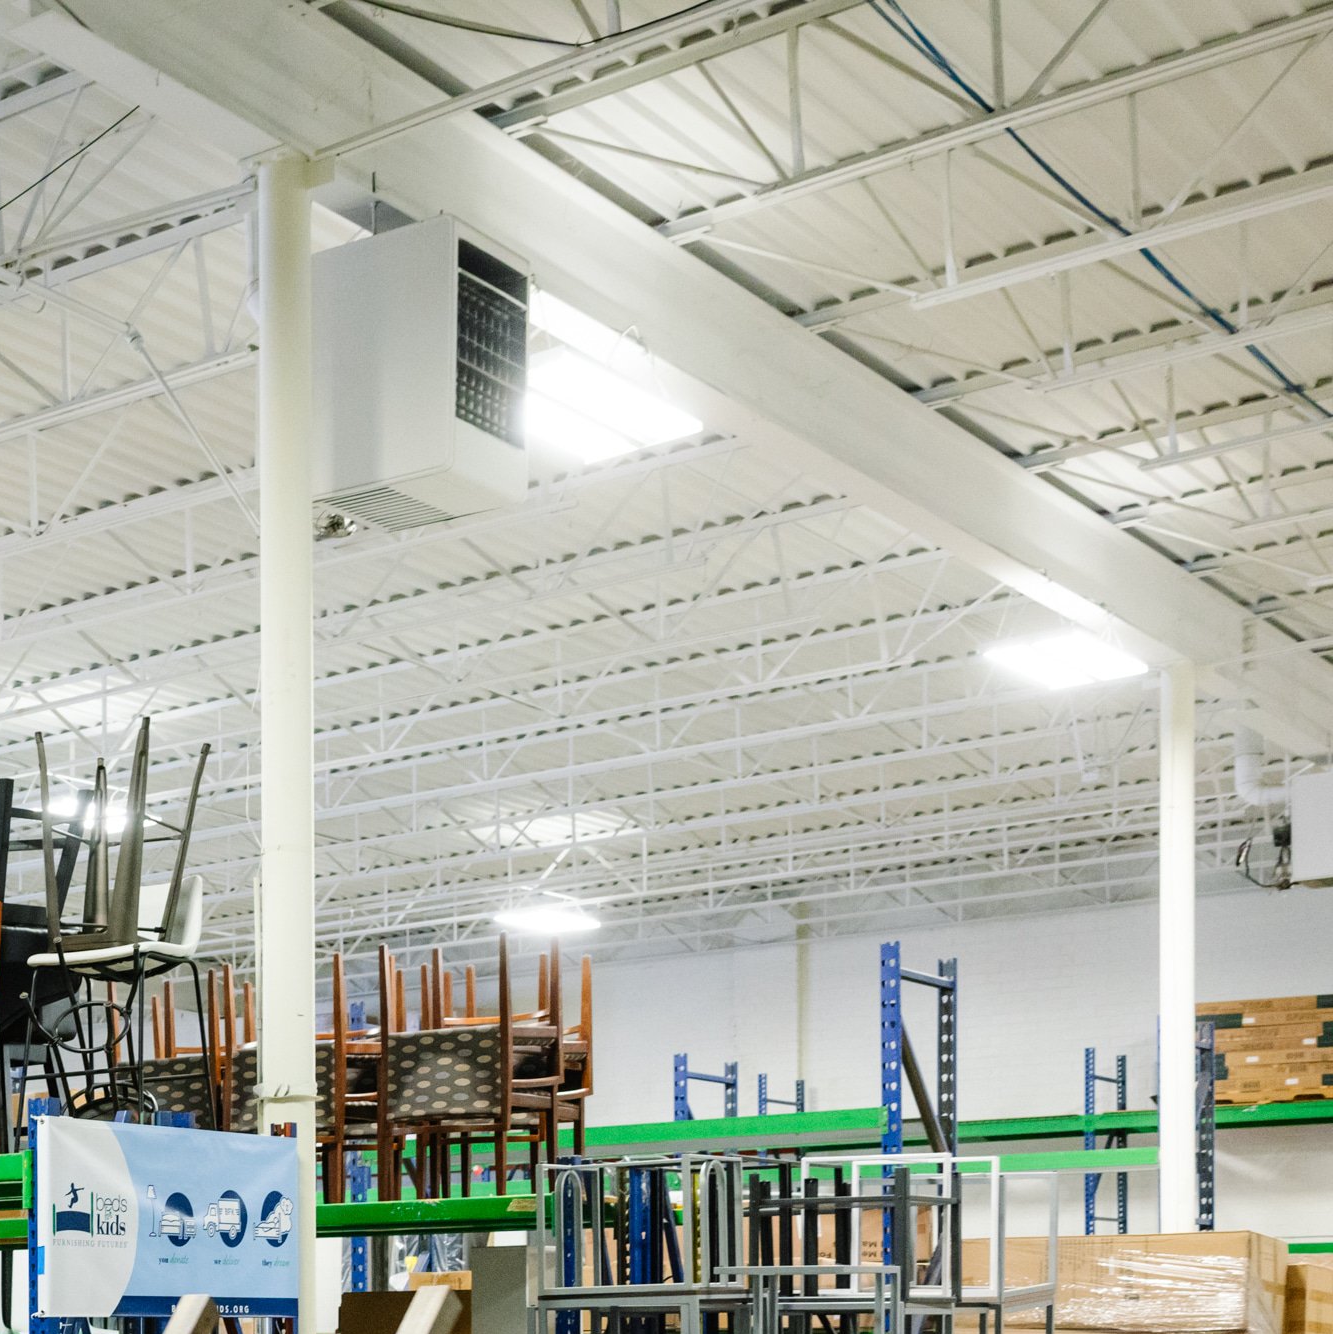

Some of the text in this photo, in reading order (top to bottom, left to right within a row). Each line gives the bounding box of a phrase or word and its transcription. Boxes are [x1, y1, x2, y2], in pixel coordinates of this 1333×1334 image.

[96, 1193, 127, 1212] beds
[96, 1214, 126, 1236] kids
[52, 1239, 95, 1248] FURNISHING
